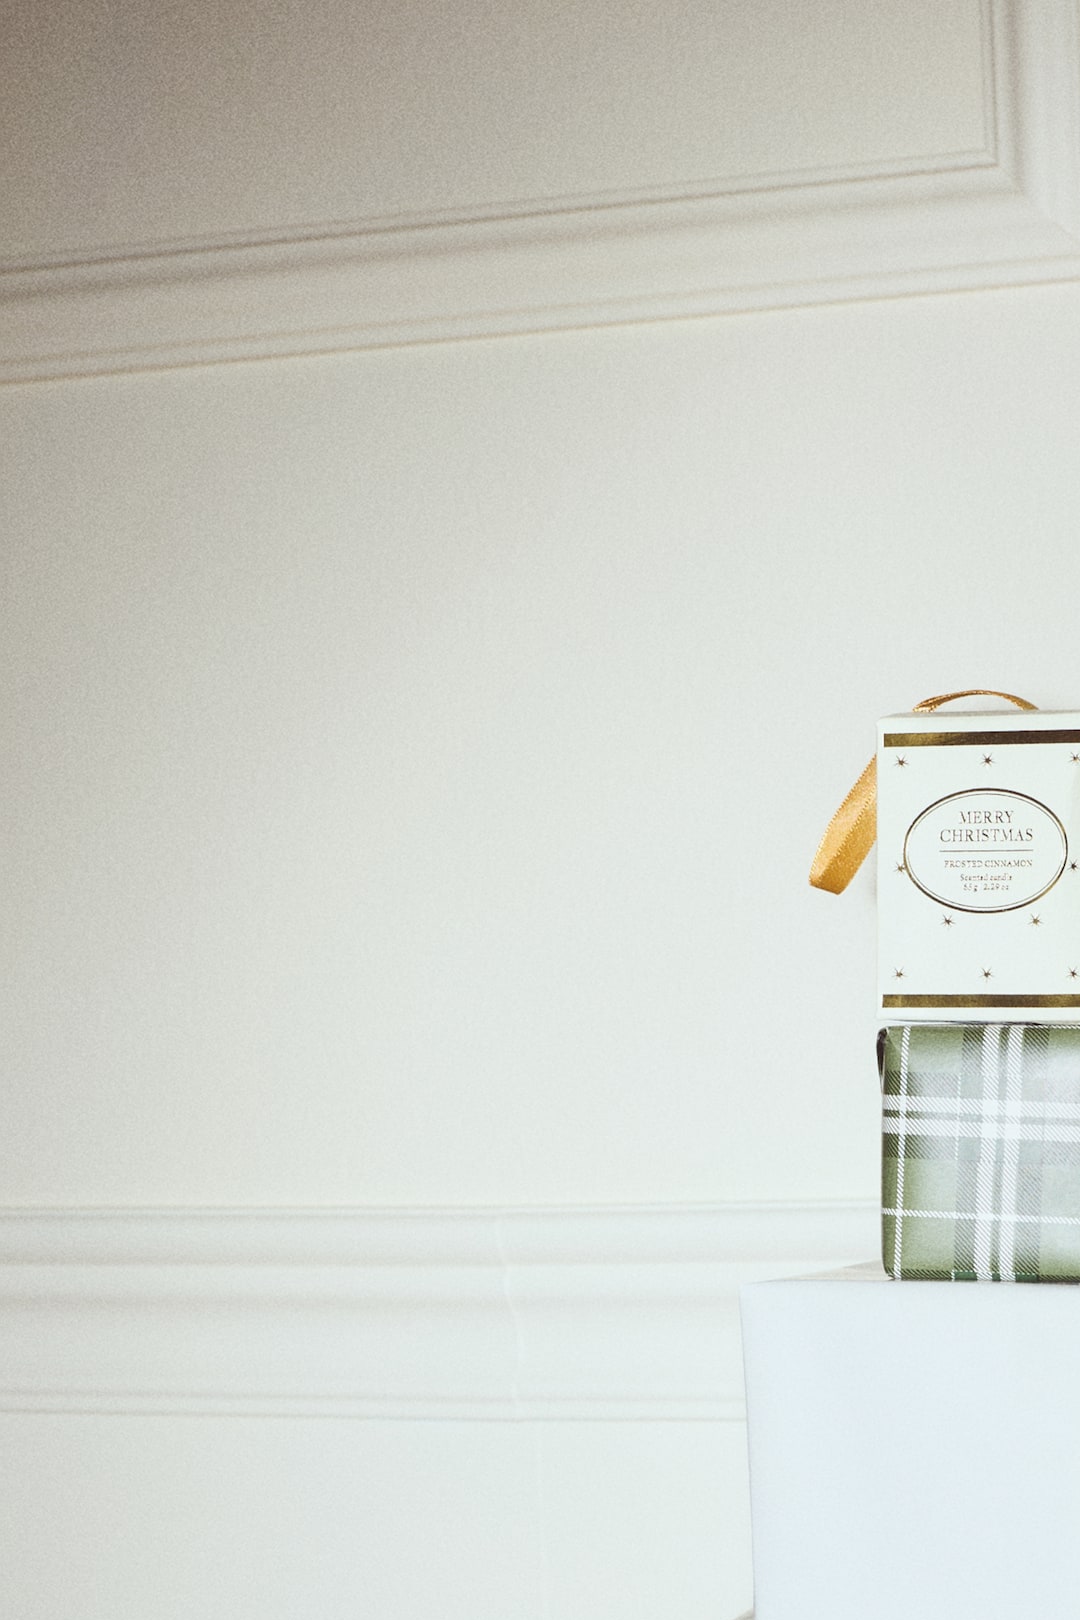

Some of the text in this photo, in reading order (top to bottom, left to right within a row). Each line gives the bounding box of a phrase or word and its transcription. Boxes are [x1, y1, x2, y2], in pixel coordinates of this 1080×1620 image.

[959, 810, 1014, 824] MERRY
[940, 828, 1033, 843] CHRISTMAS
[944, 859, 1033, 868] FROSTED CINNAMON
